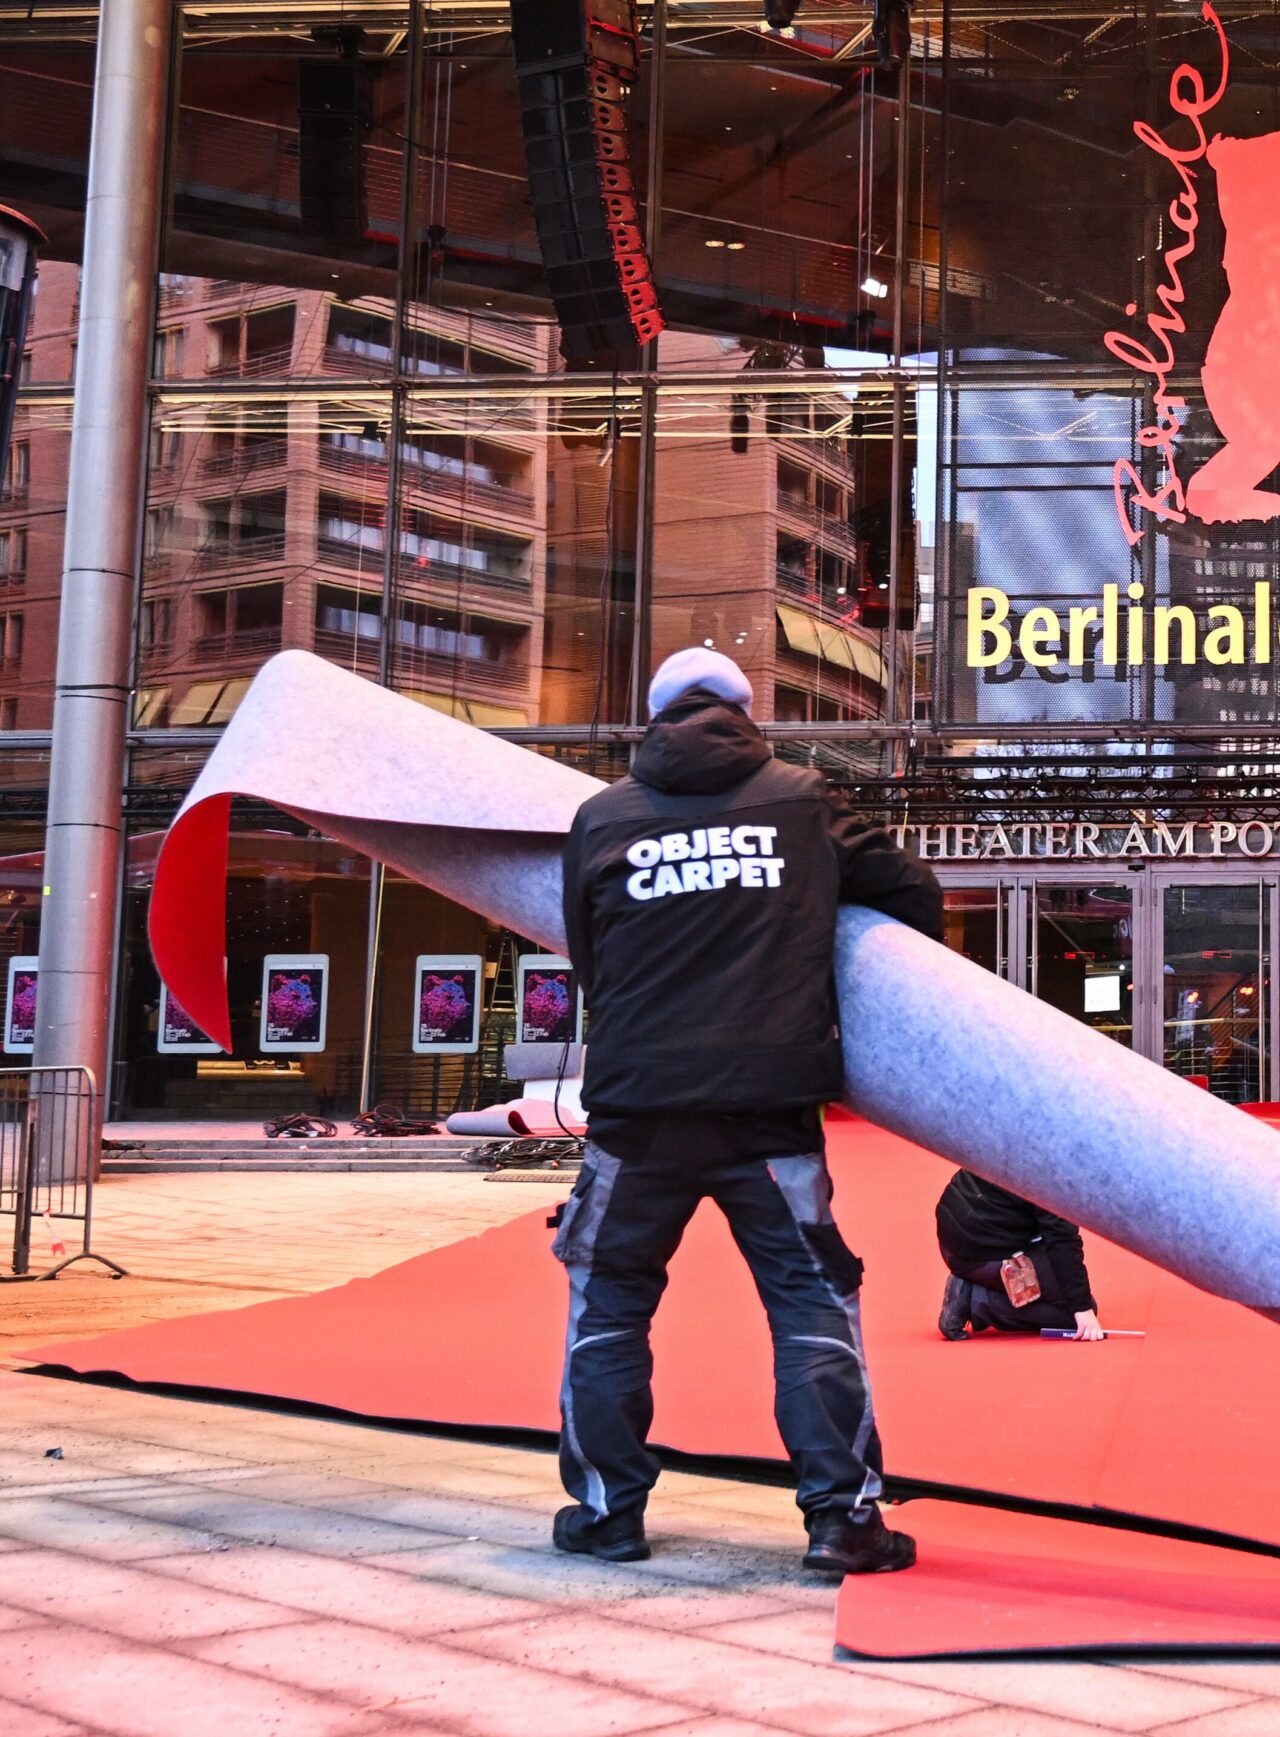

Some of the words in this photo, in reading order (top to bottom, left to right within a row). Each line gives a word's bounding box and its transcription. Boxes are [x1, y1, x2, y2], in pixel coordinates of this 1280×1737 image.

[1103, 2, 1229, 545] Berlinale
[626, 825, 778, 868] OBJECT
[887, 822, 1106, 859] THEATER
[1117, 821, 1199, 857] AM
[626, 857, 785, 900] CARPET
